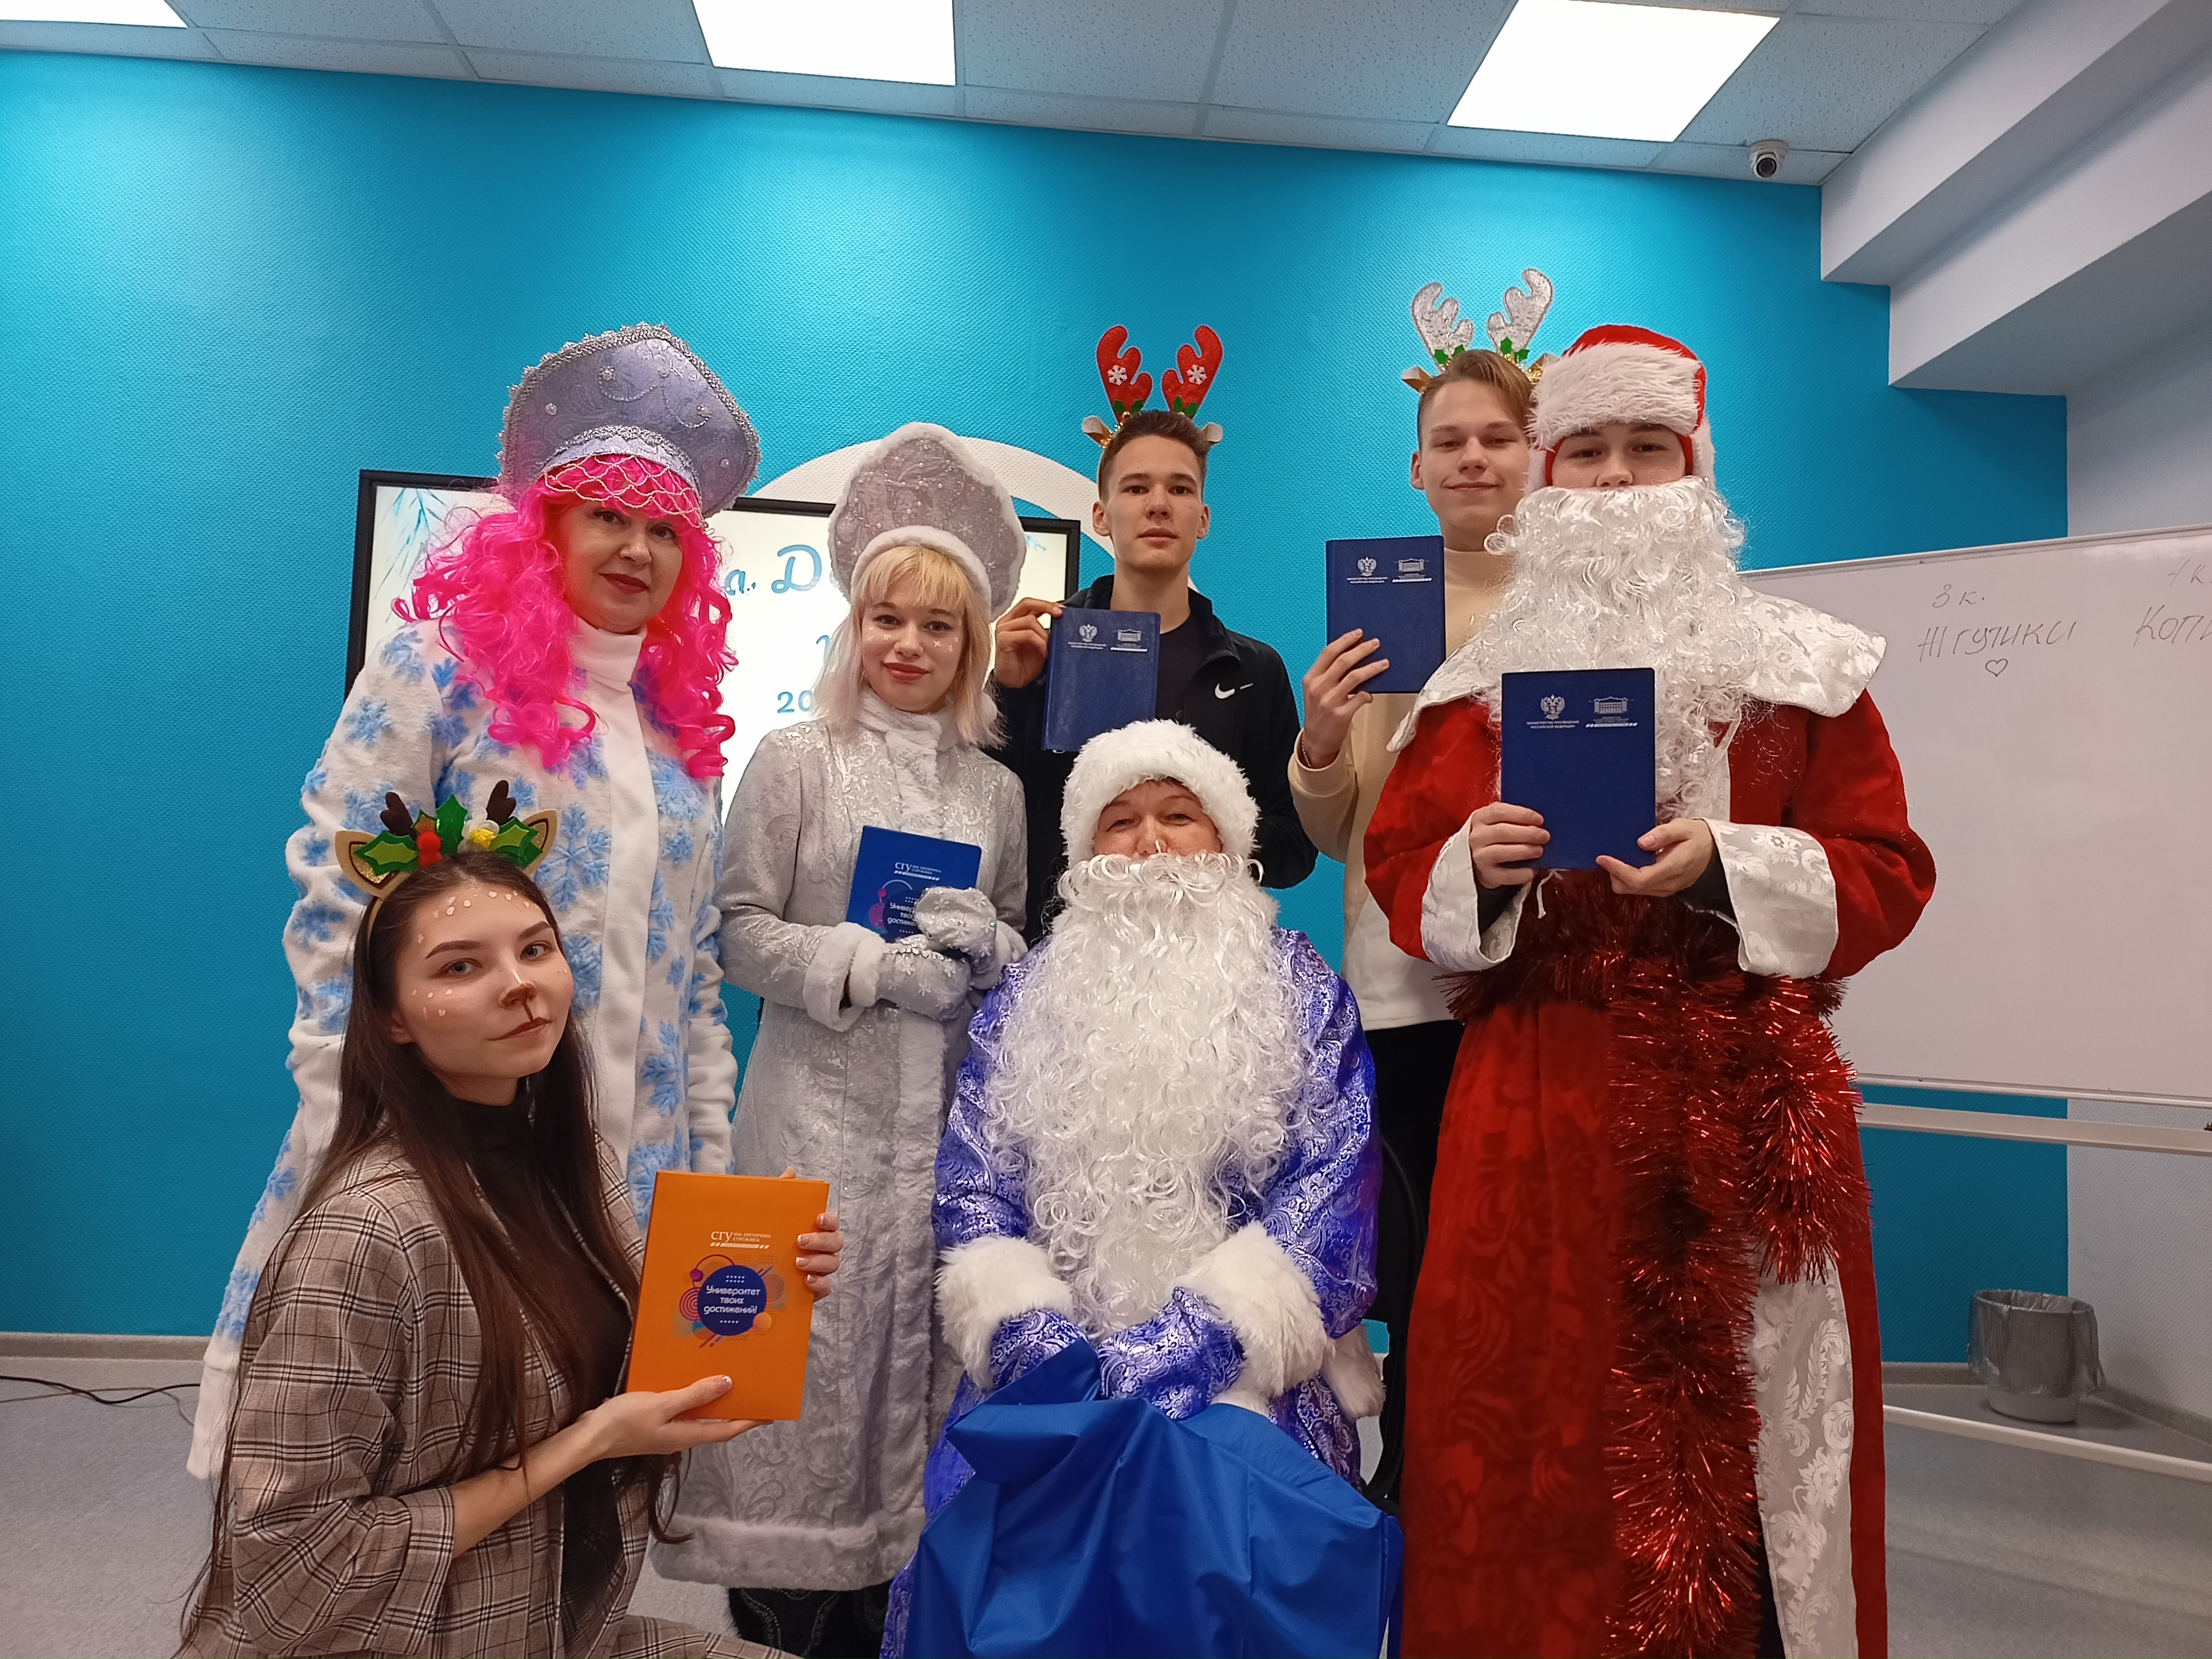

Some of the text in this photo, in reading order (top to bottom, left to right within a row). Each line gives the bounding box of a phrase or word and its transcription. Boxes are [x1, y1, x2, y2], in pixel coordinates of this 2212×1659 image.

[895, 862, 912, 873] СГУ
[890, 902, 914, 914] Универ
[711, 1231, 733, 1243] СГУ
[706, 1285, 760, 1297] Университет
[703, 1306, 758, 1315] достижений!
